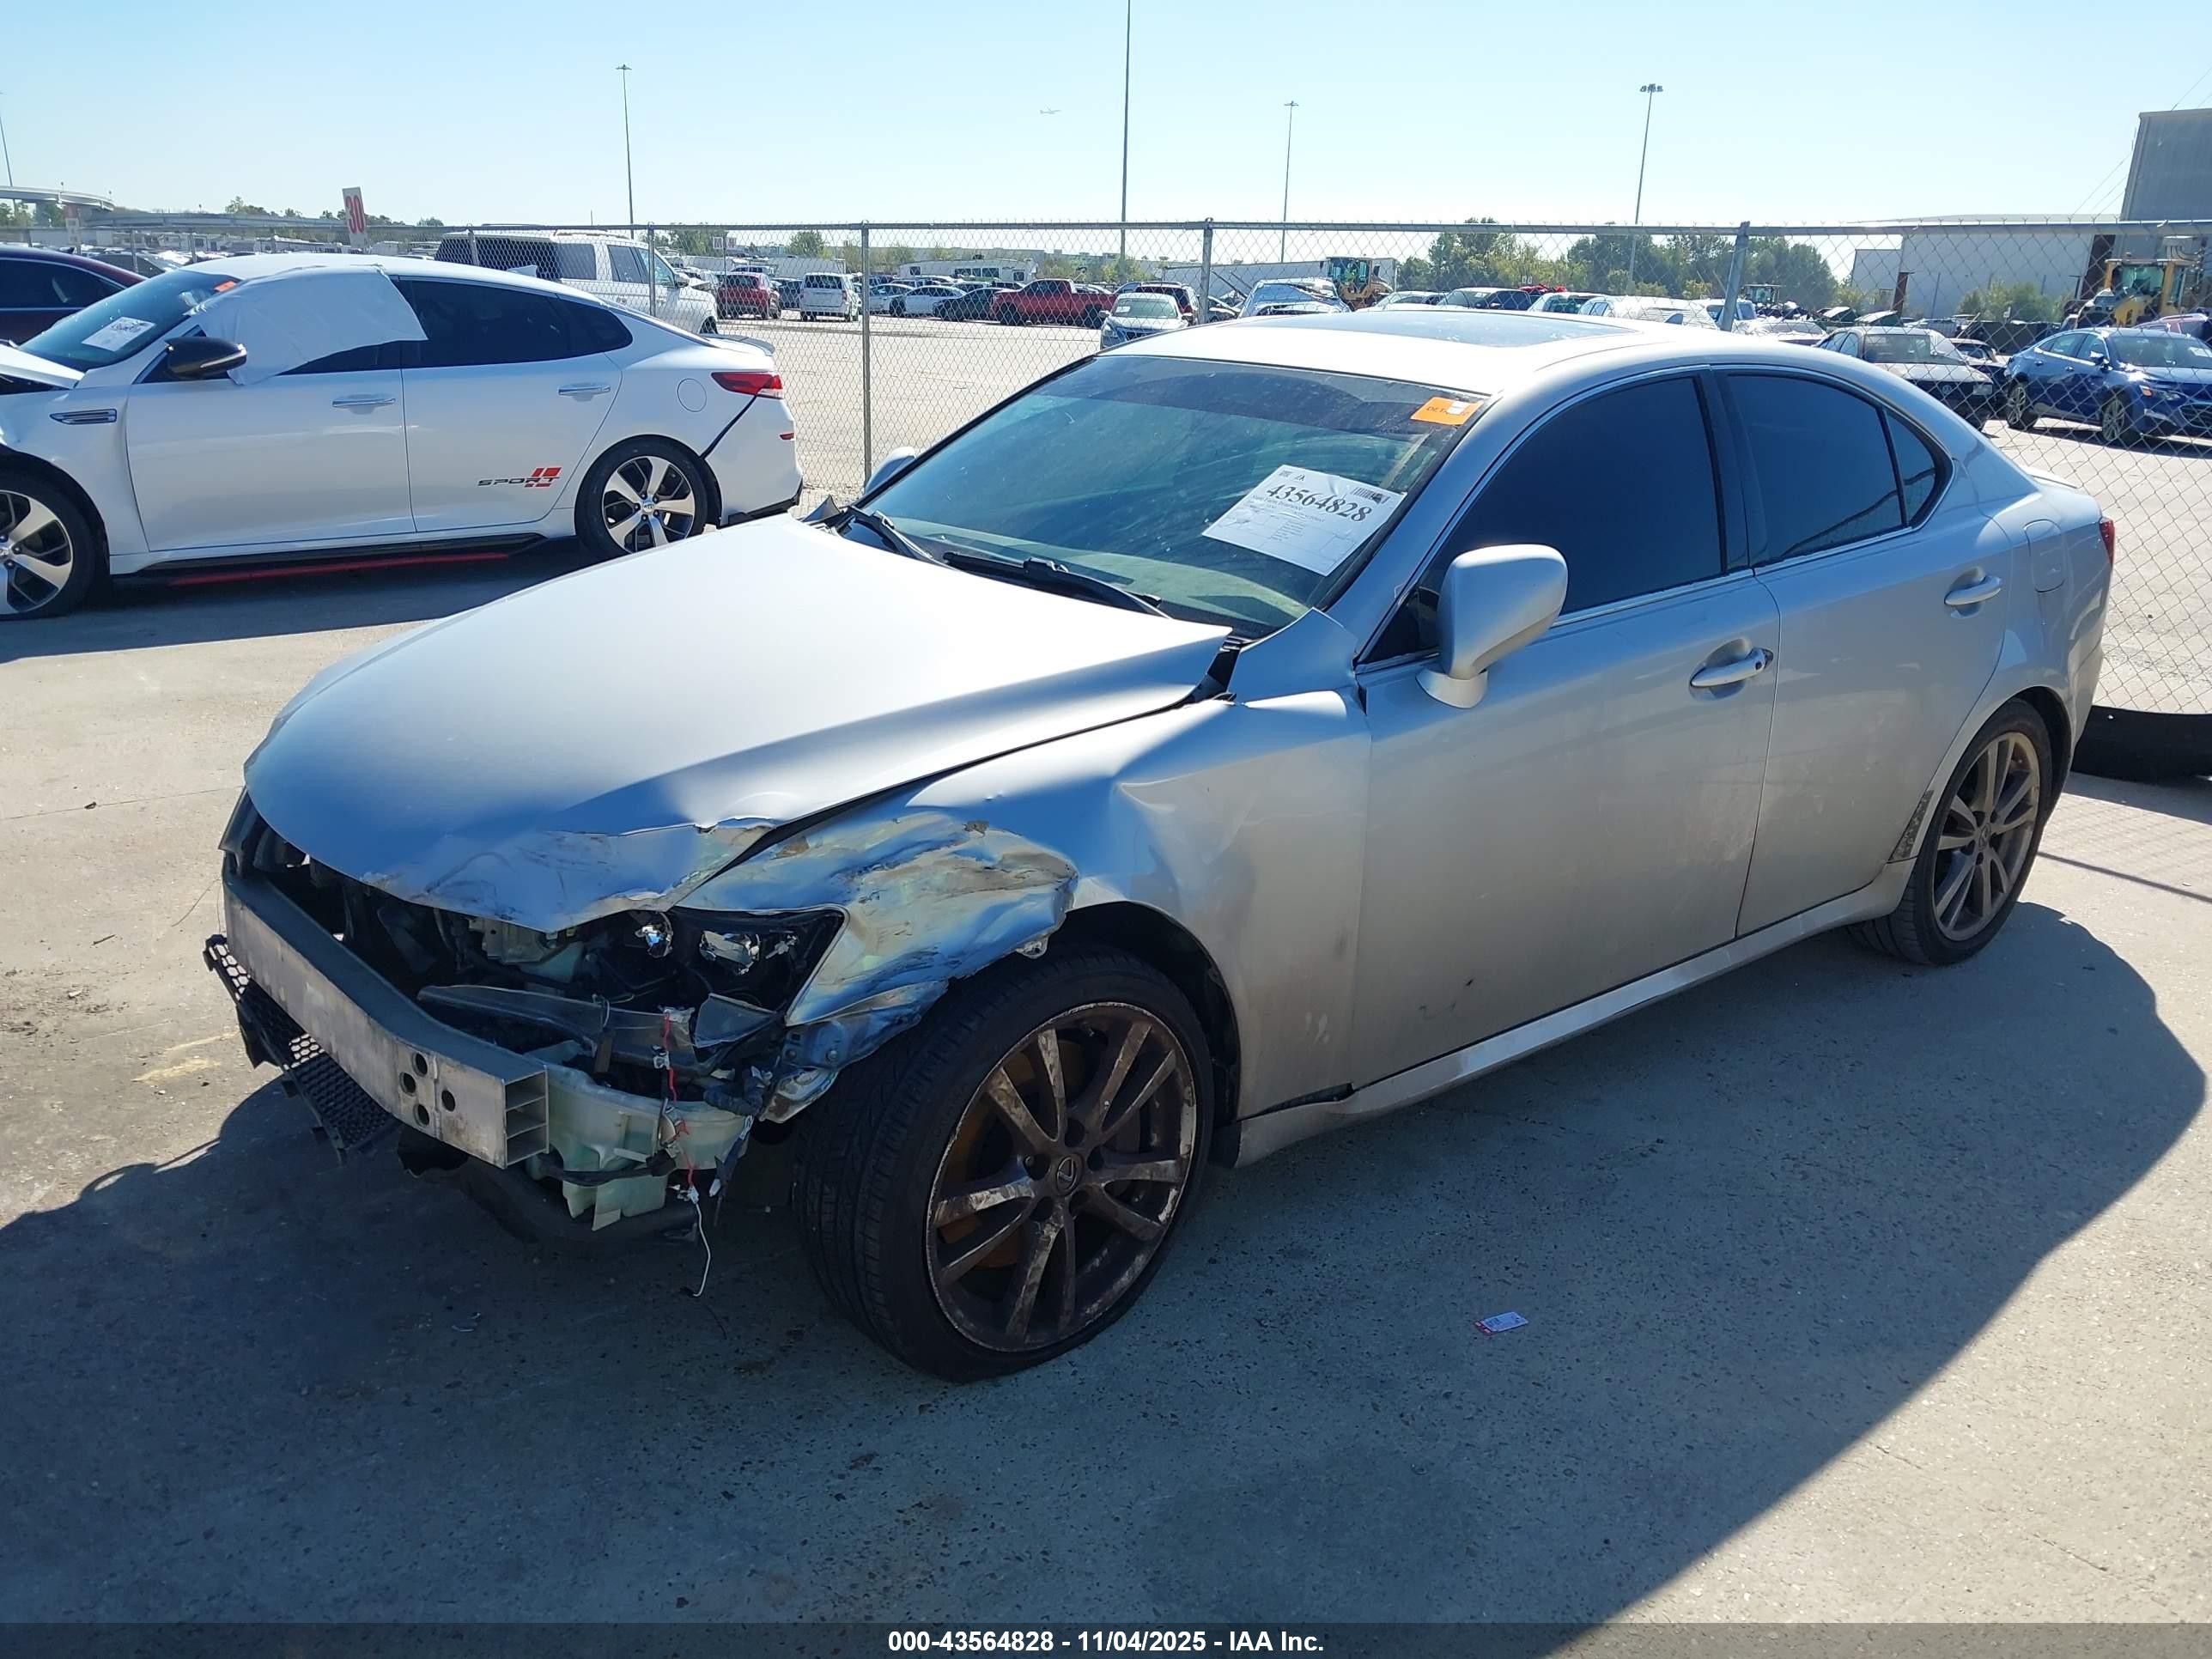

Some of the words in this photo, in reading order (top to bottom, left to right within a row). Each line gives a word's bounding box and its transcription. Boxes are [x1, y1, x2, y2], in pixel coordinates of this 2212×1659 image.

[345, 195, 366, 234] 30
[477, 477, 560, 487] SPORT
[1267, 484, 1373, 522] 43564828
